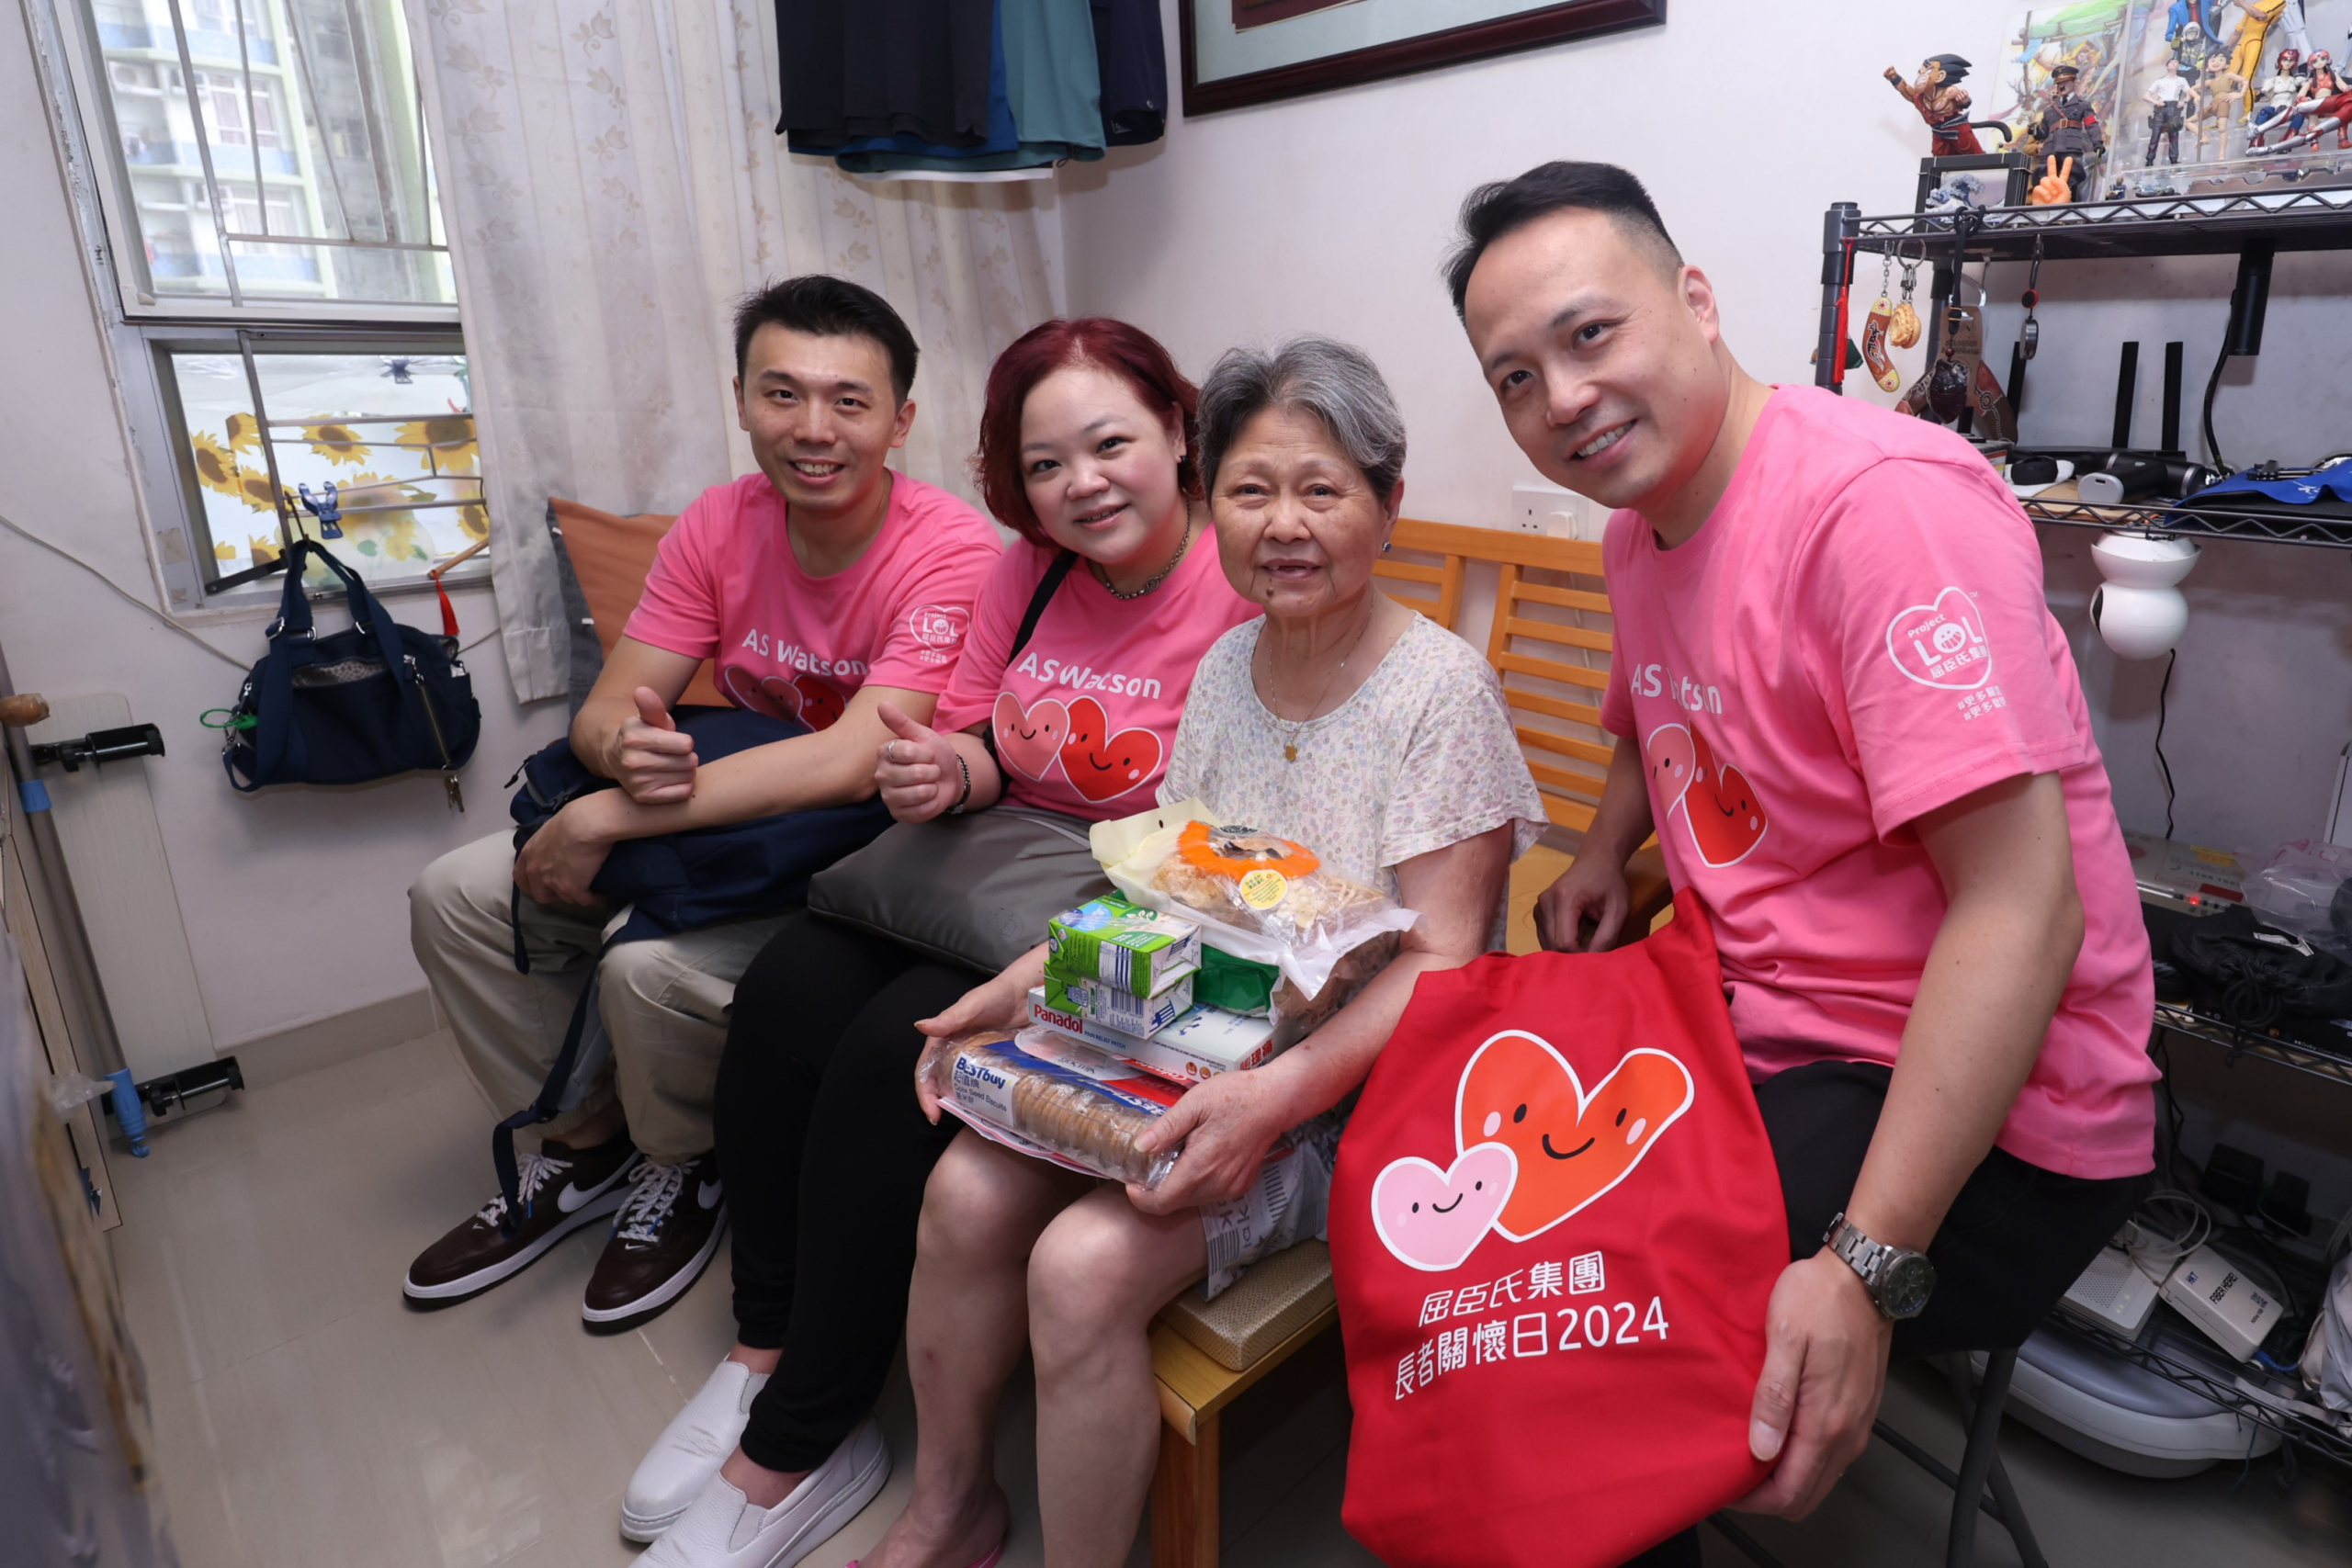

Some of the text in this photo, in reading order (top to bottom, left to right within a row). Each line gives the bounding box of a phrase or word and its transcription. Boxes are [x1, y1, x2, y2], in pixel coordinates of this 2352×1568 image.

[1907, 613, 1947, 638] Project
[741, 628, 868, 677] AS Watson
[1016, 651, 1161, 700] AS Watson
[1631, 663, 1662, 698] AS
[1034, 1003, 1083, 1034] Panadol
[1111, 1039, 1126, 1050] PATCH
[956, 1056, 1006, 1089] BESTbuy
[1419, 1250, 1605, 1327] 屈臣氏集團
[2186, 1270, 2199, 1285] HKT
[2209, 1286, 2226, 1304] FIBER
